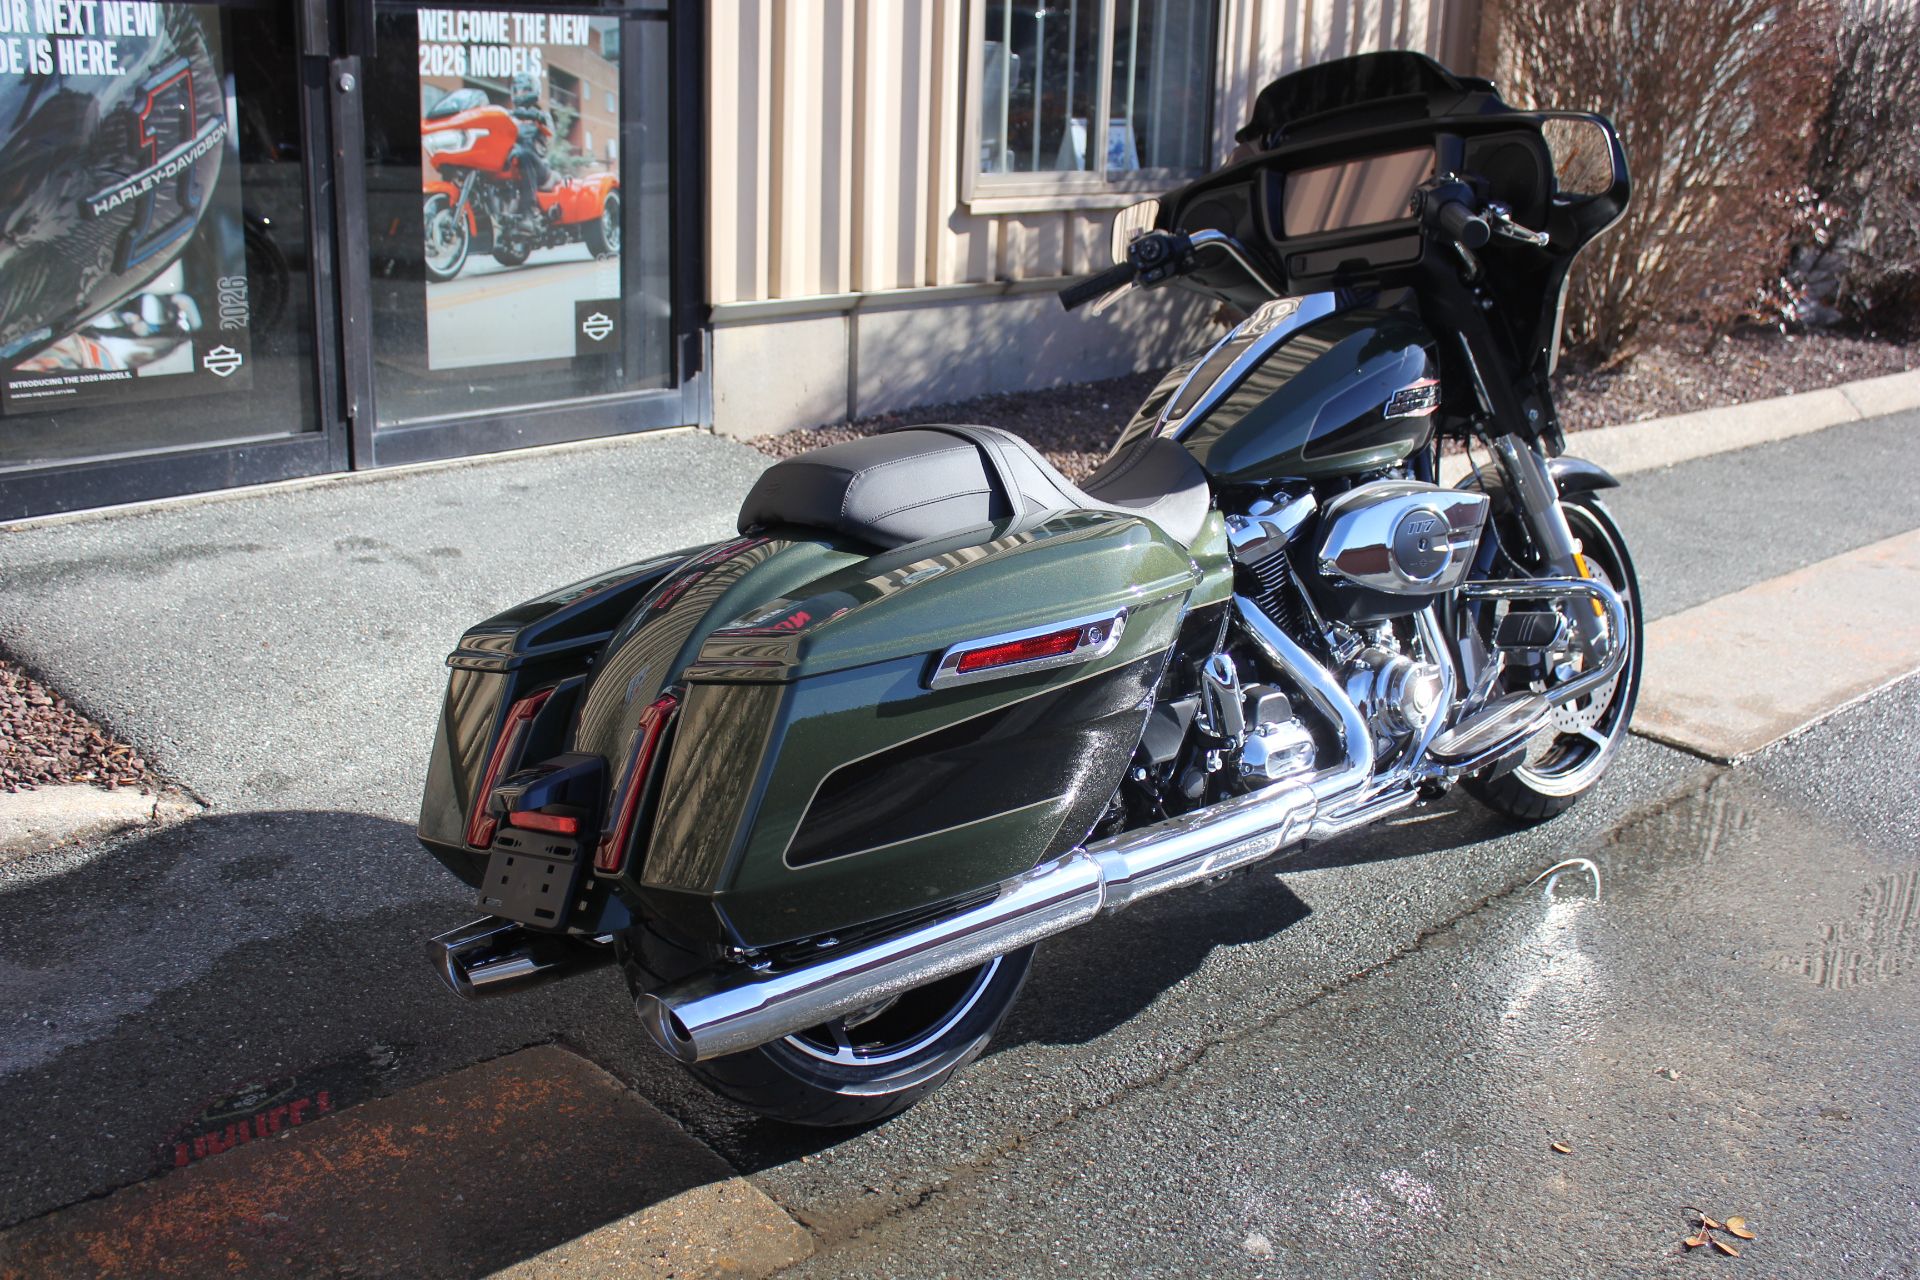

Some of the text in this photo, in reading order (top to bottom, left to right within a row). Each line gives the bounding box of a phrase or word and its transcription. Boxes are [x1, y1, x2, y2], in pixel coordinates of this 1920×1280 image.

[35, 0, 97, 35] NEXT
[103, 1, 157, 37] NEW
[417, 9, 590, 46] WELCOME THE NEW
[28, 38, 54, 75] IS
[57, 38, 126, 76] HERE.
[419, 44, 547, 78] 2026 MODELS.
[93, 121, 228, 216] HARLEY-DAVIDSON
[217, 275, 249, 330] 2026
[9, 377, 63, 389] INTRODUCING
[63, 375, 79, 384] THE
[79, 374, 99, 382] 2026
[1407, 518, 1436, 535] 117
